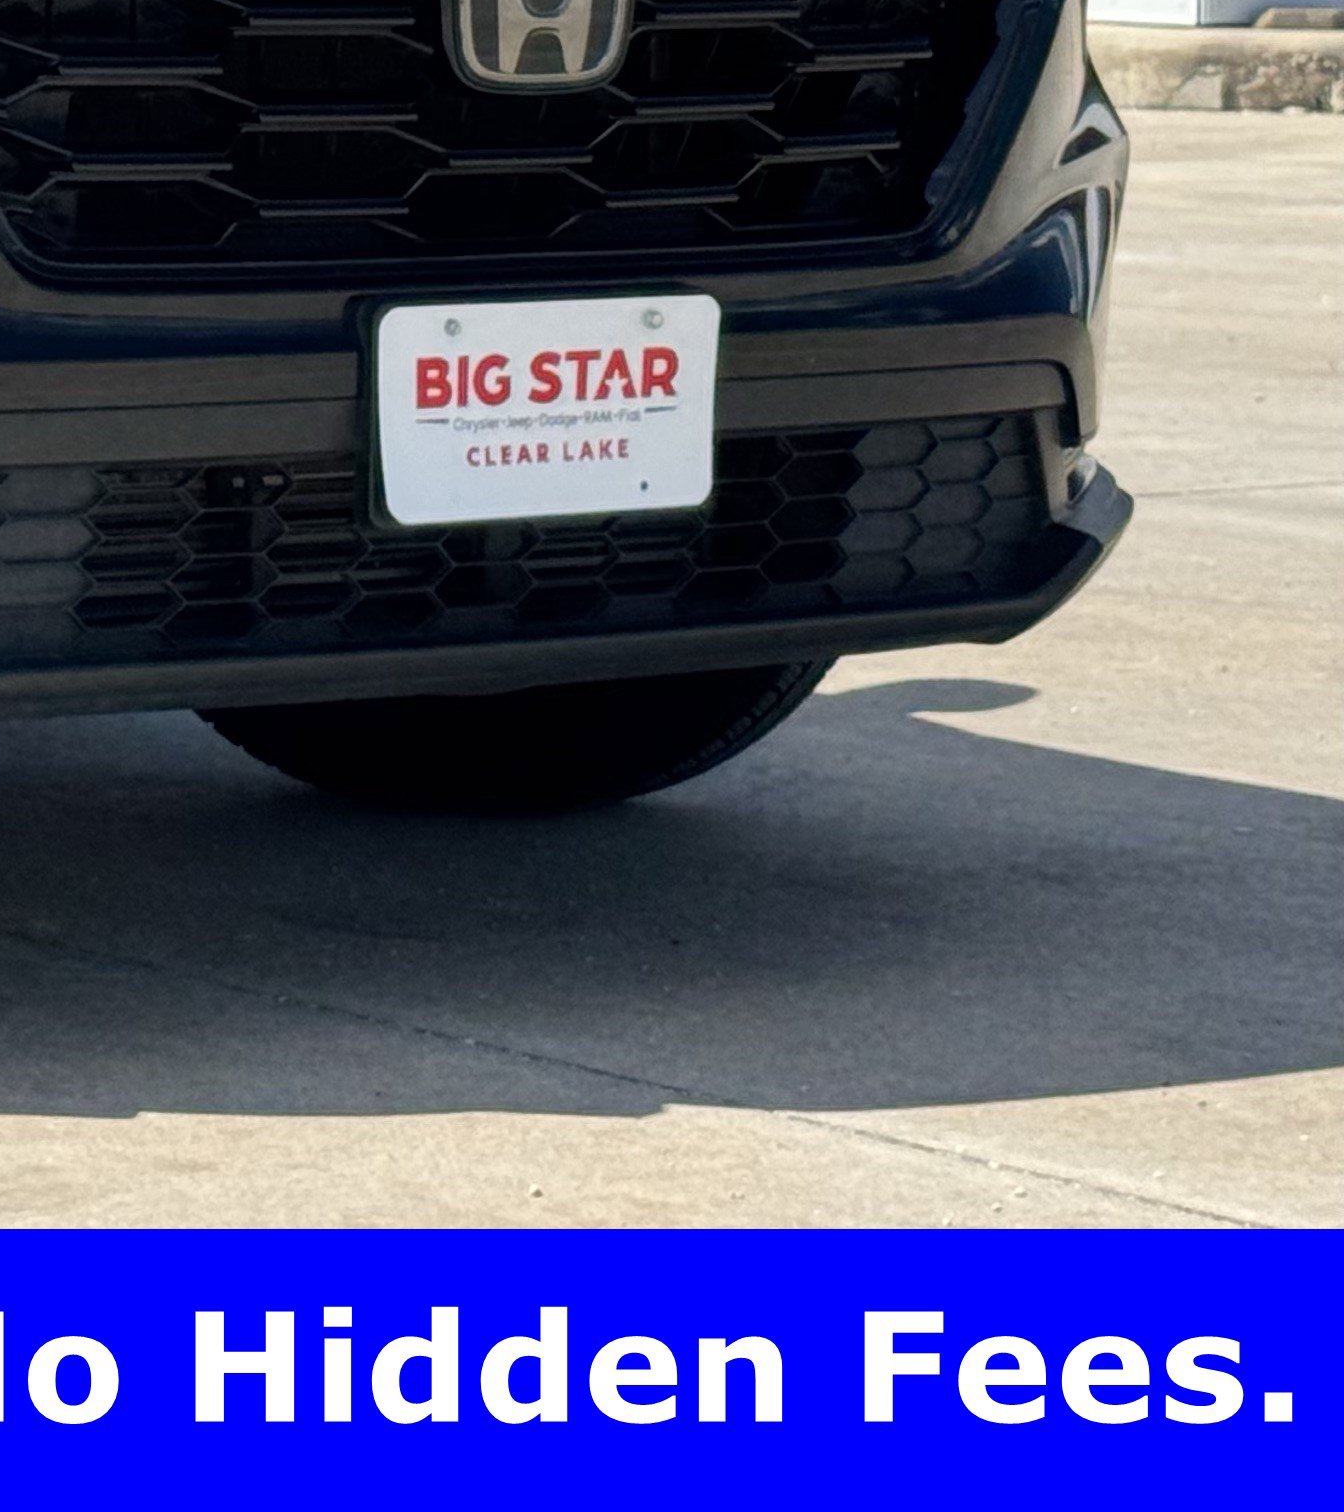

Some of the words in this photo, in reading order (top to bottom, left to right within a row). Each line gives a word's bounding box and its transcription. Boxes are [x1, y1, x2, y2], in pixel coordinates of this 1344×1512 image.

[416, 353, 512, 409] BIG
[528, 346, 679, 404] STAR
[466, 442, 551, 468] CLEAR
[562, 438, 630, 463] LAKE
